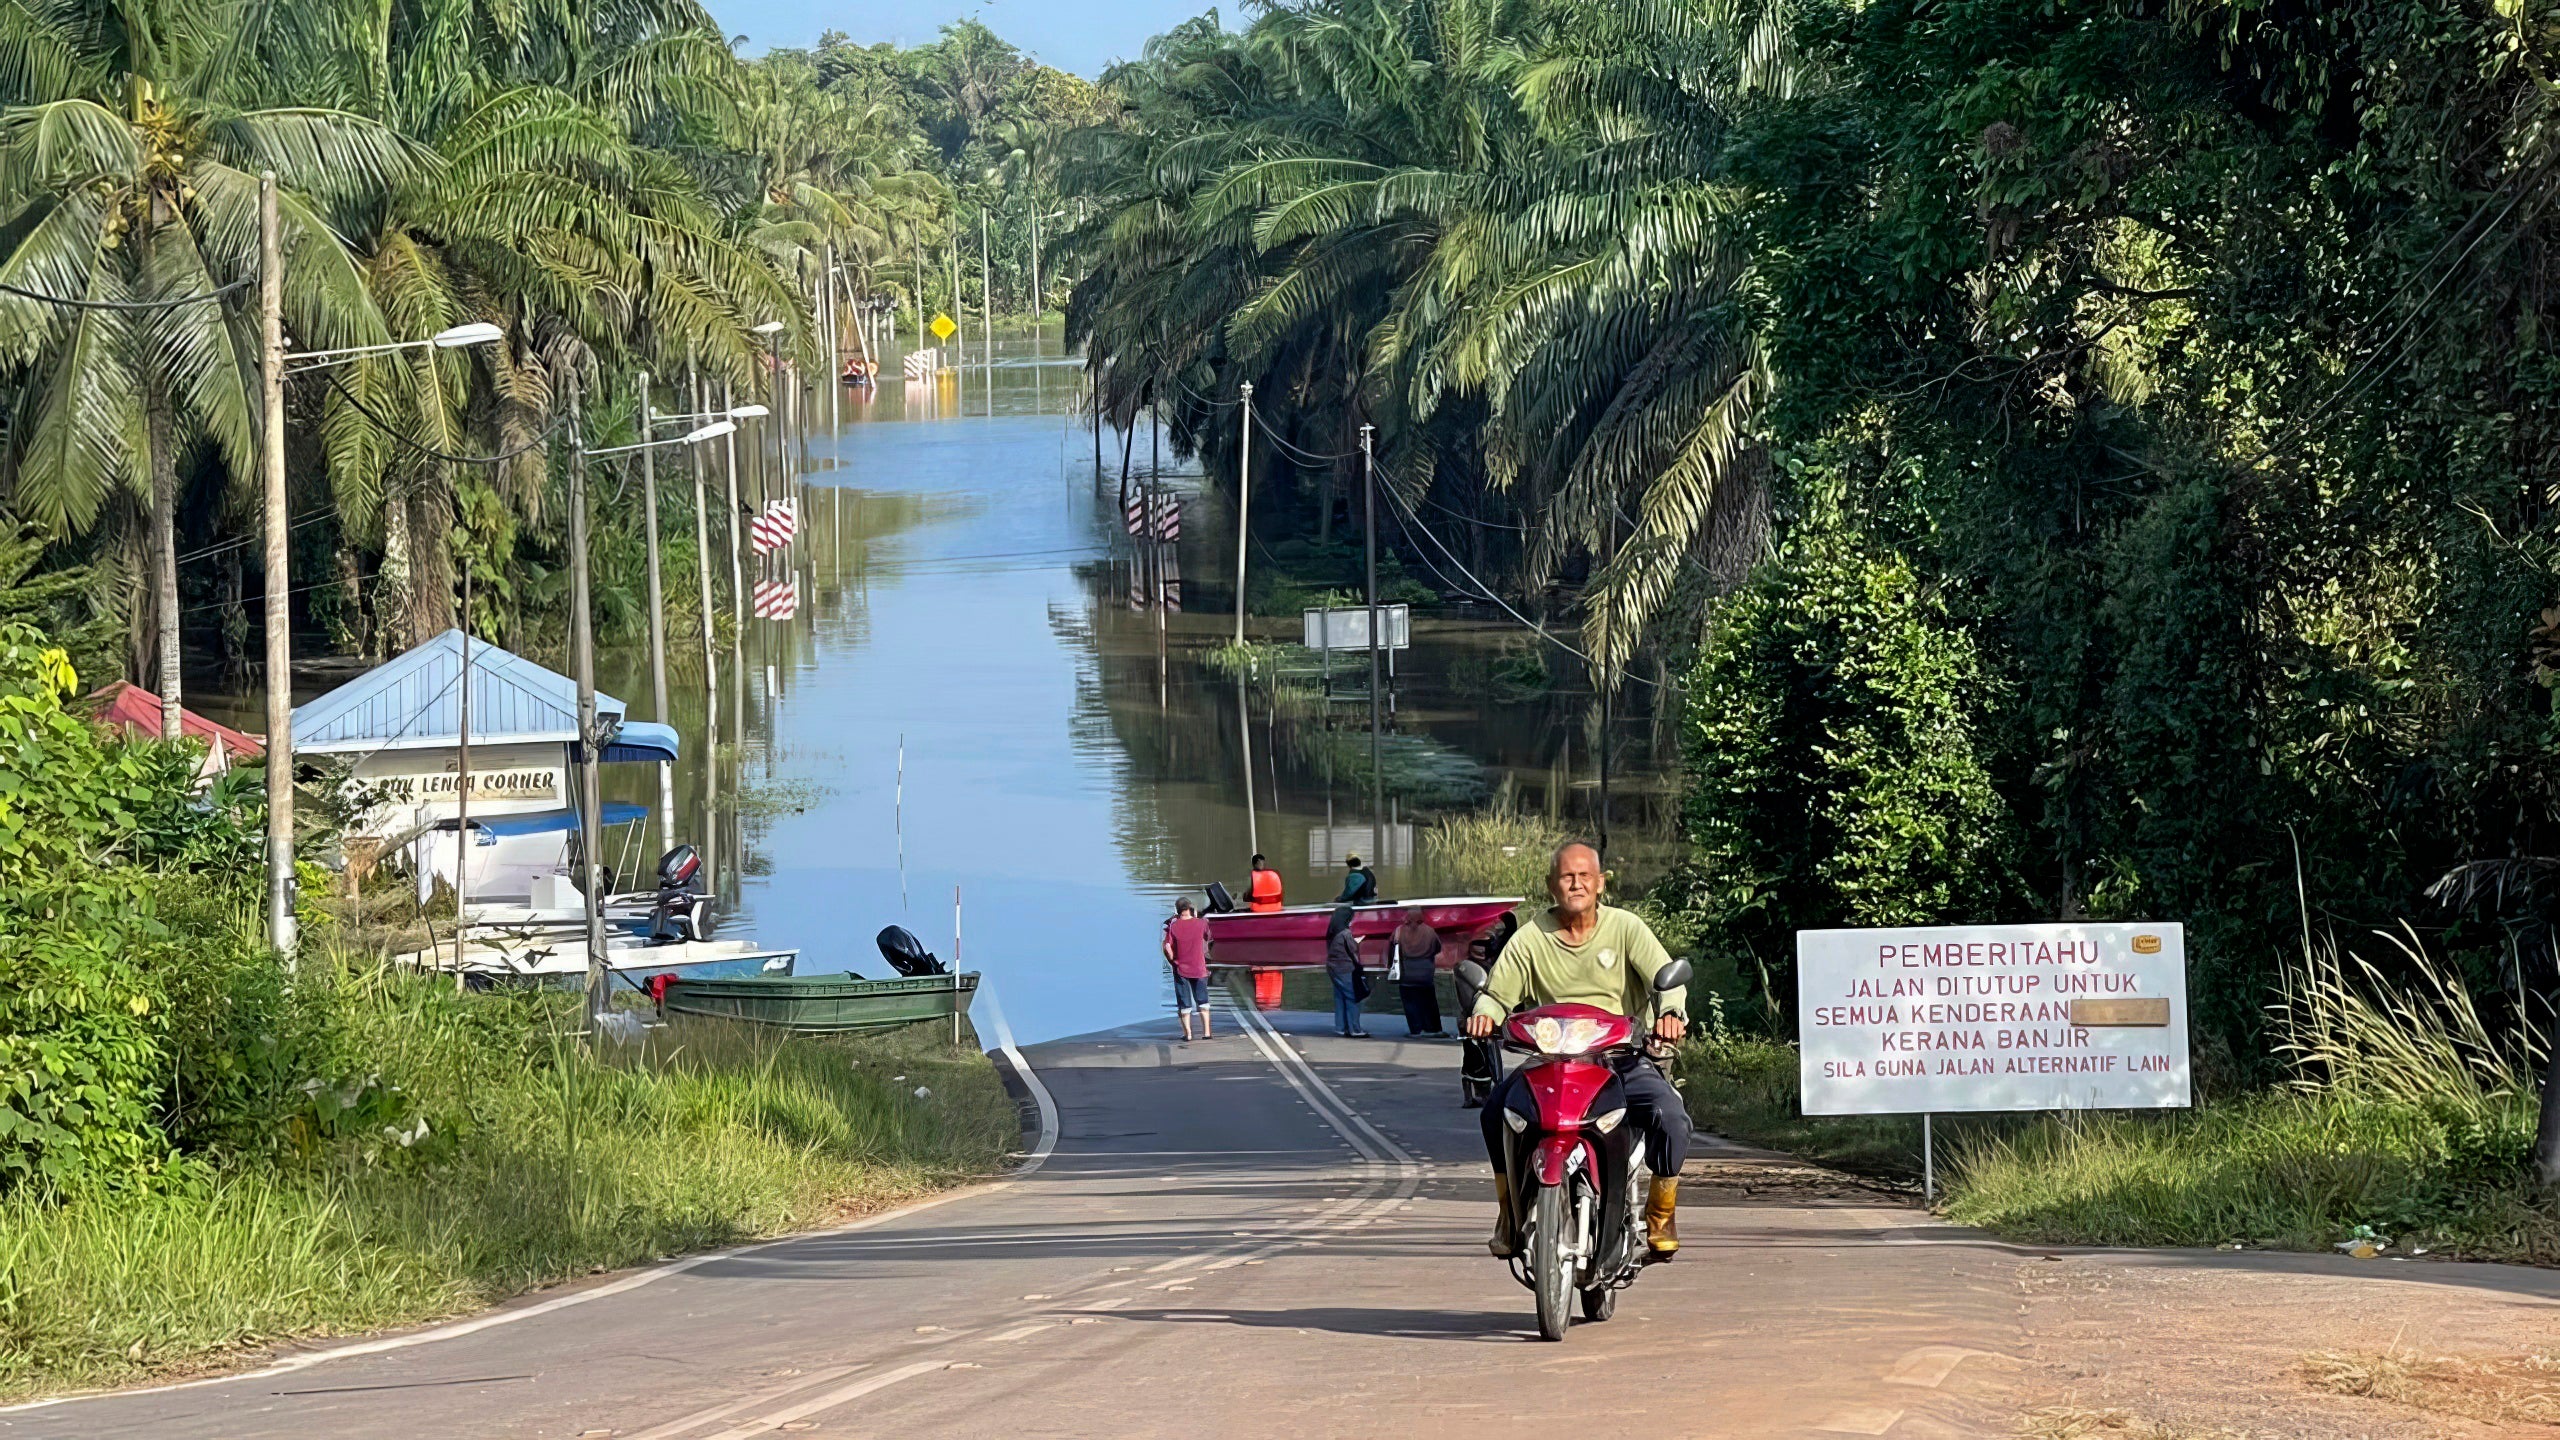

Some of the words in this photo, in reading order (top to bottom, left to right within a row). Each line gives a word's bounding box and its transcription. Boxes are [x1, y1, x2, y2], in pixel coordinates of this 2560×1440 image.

[483, 771, 554, 789] CORNER
[1879, 940, 2099, 968] PEMBERITAHU
[1845, 976, 1924, 998] JALAN
[1937, 974, 2041, 996] DITUTUP
[2054, 973, 2137, 993] UNTUK
[1815, 1005, 1899, 1026] SEMUA
[1911, 1001, 2070, 1024] KENDERAAN
[1882, 1030, 1986, 1052] KERANA
[1997, 1028, 2090, 1049] BANJIR
[1823, 1061, 1866, 1078] SILA
[1875, 1058, 1926, 1077] GUNA
[1935, 1058, 1995, 1075] JALAN
[2005, 1055, 2118, 1074] ALTERNATIF
[2127, 1054, 2171, 1073] LAIN
